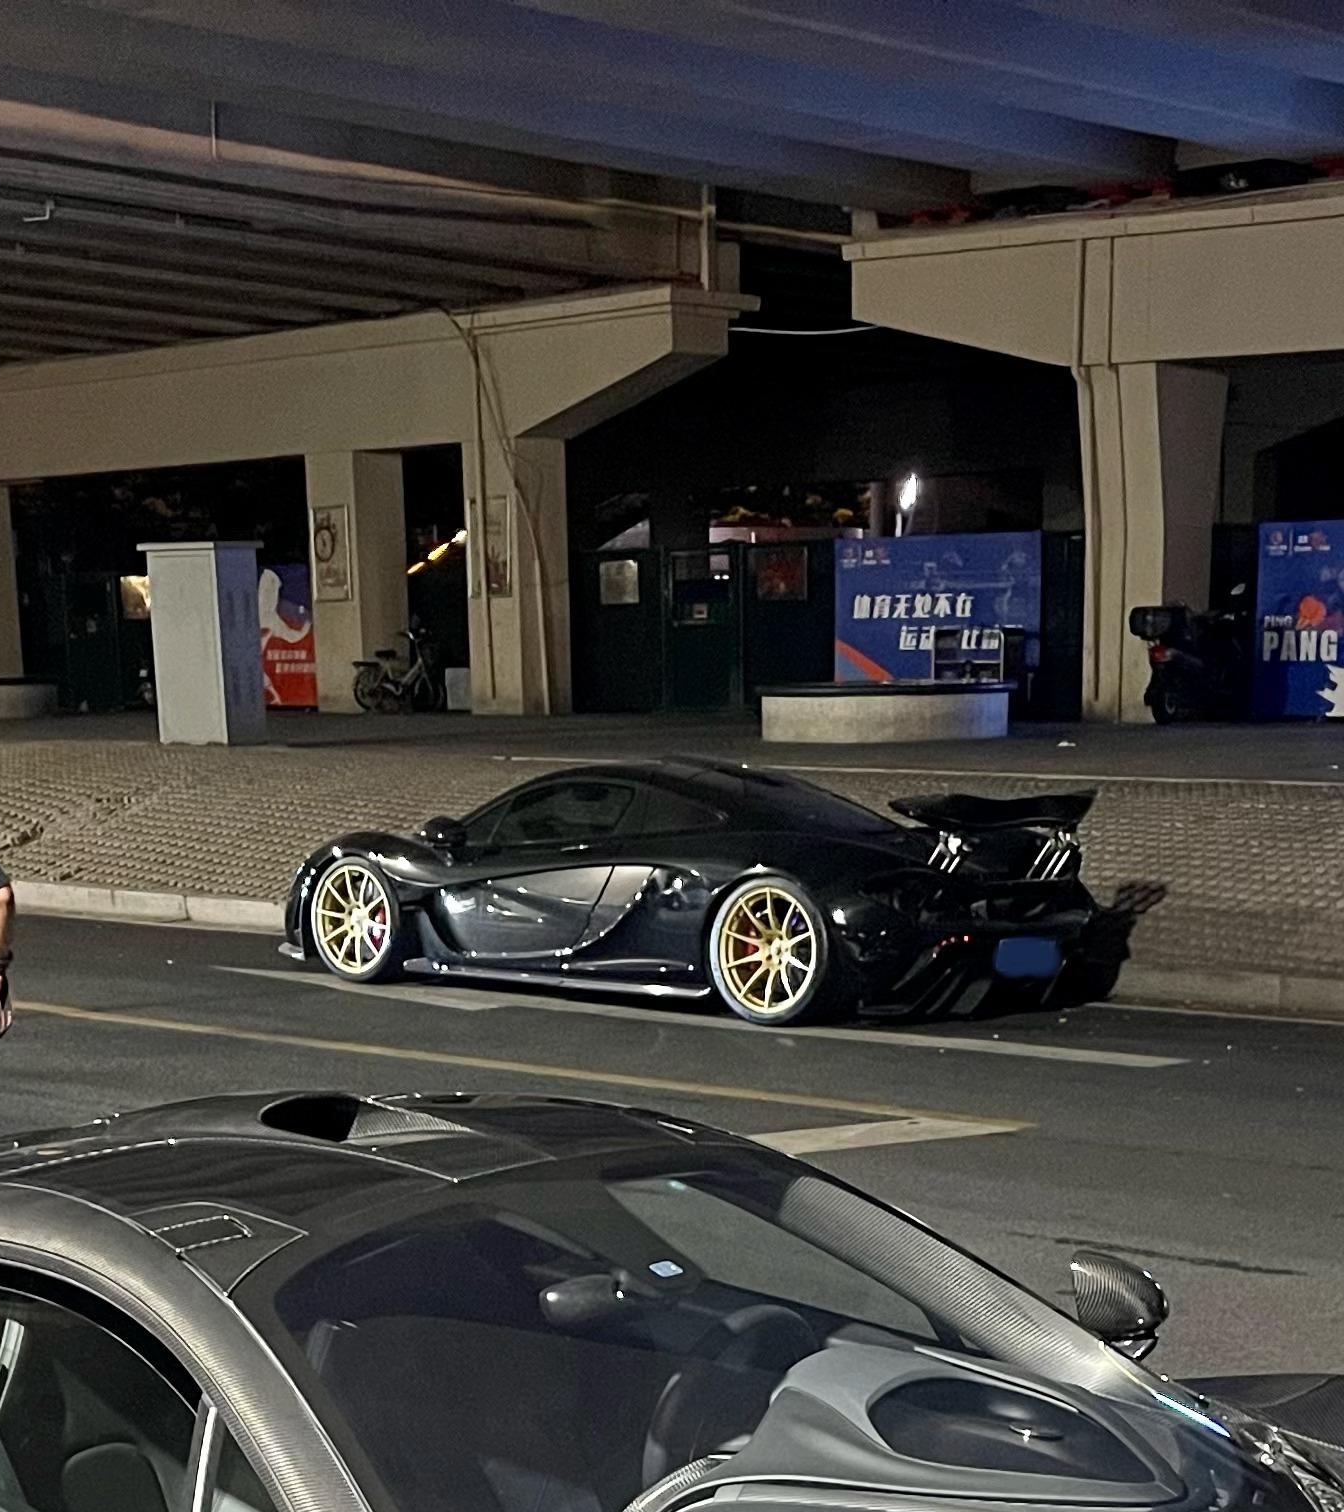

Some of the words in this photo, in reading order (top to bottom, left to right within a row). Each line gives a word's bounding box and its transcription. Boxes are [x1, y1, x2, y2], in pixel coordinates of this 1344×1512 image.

[1263, 615, 1293, 628] PING
[899, 624, 1023, 650] 运动比
[1262, 629, 1338, 661] PANG
